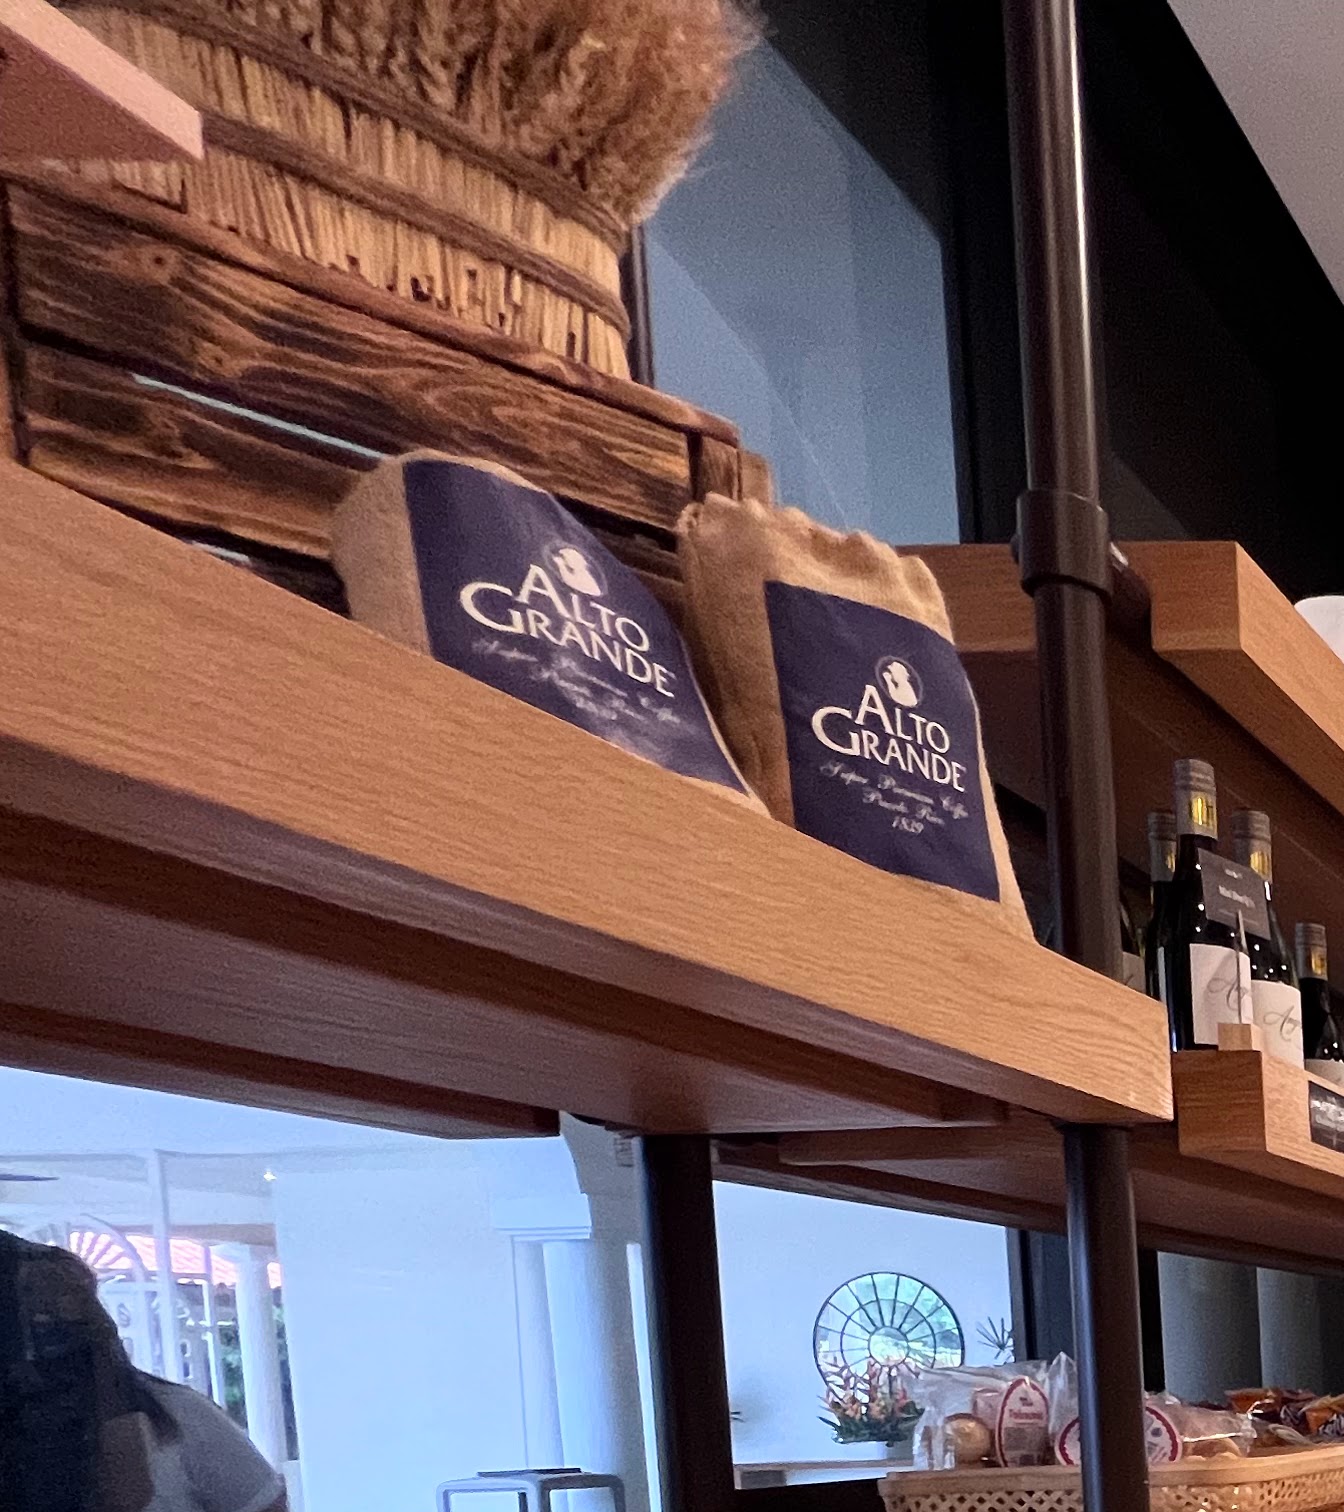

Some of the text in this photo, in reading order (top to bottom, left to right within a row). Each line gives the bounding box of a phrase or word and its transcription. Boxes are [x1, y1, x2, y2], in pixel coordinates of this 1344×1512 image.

[459, 580, 675, 698] GRANDE
[518, 564, 650, 654] ALTO
[811, 706, 966, 794] GRANDE
[854, 683, 951, 755] ALTO
